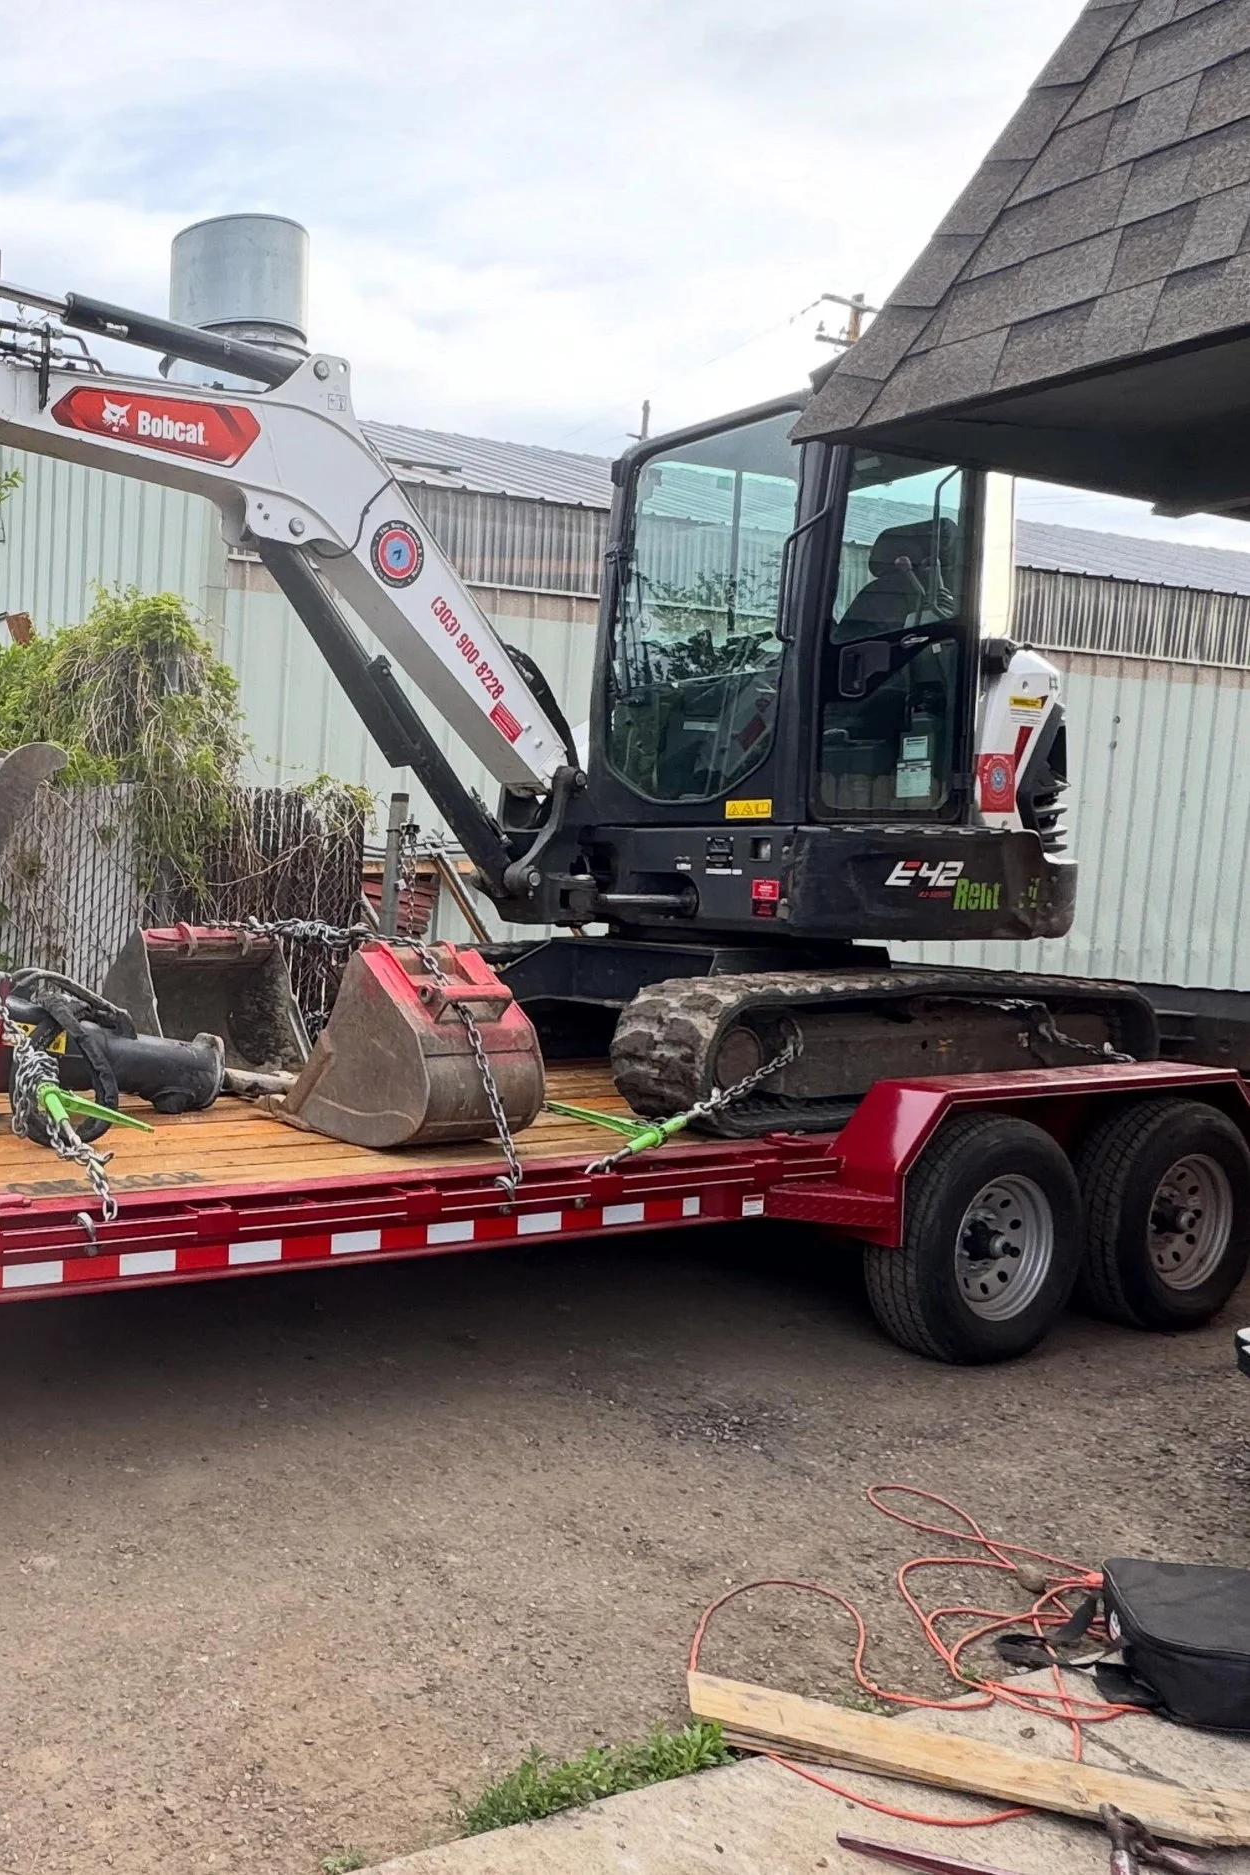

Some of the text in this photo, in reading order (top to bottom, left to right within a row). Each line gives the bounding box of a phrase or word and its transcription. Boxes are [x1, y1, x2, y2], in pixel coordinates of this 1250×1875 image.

[430, 596, 505, 701] (303) 900-8228
[884, 860, 965, 887] E42
